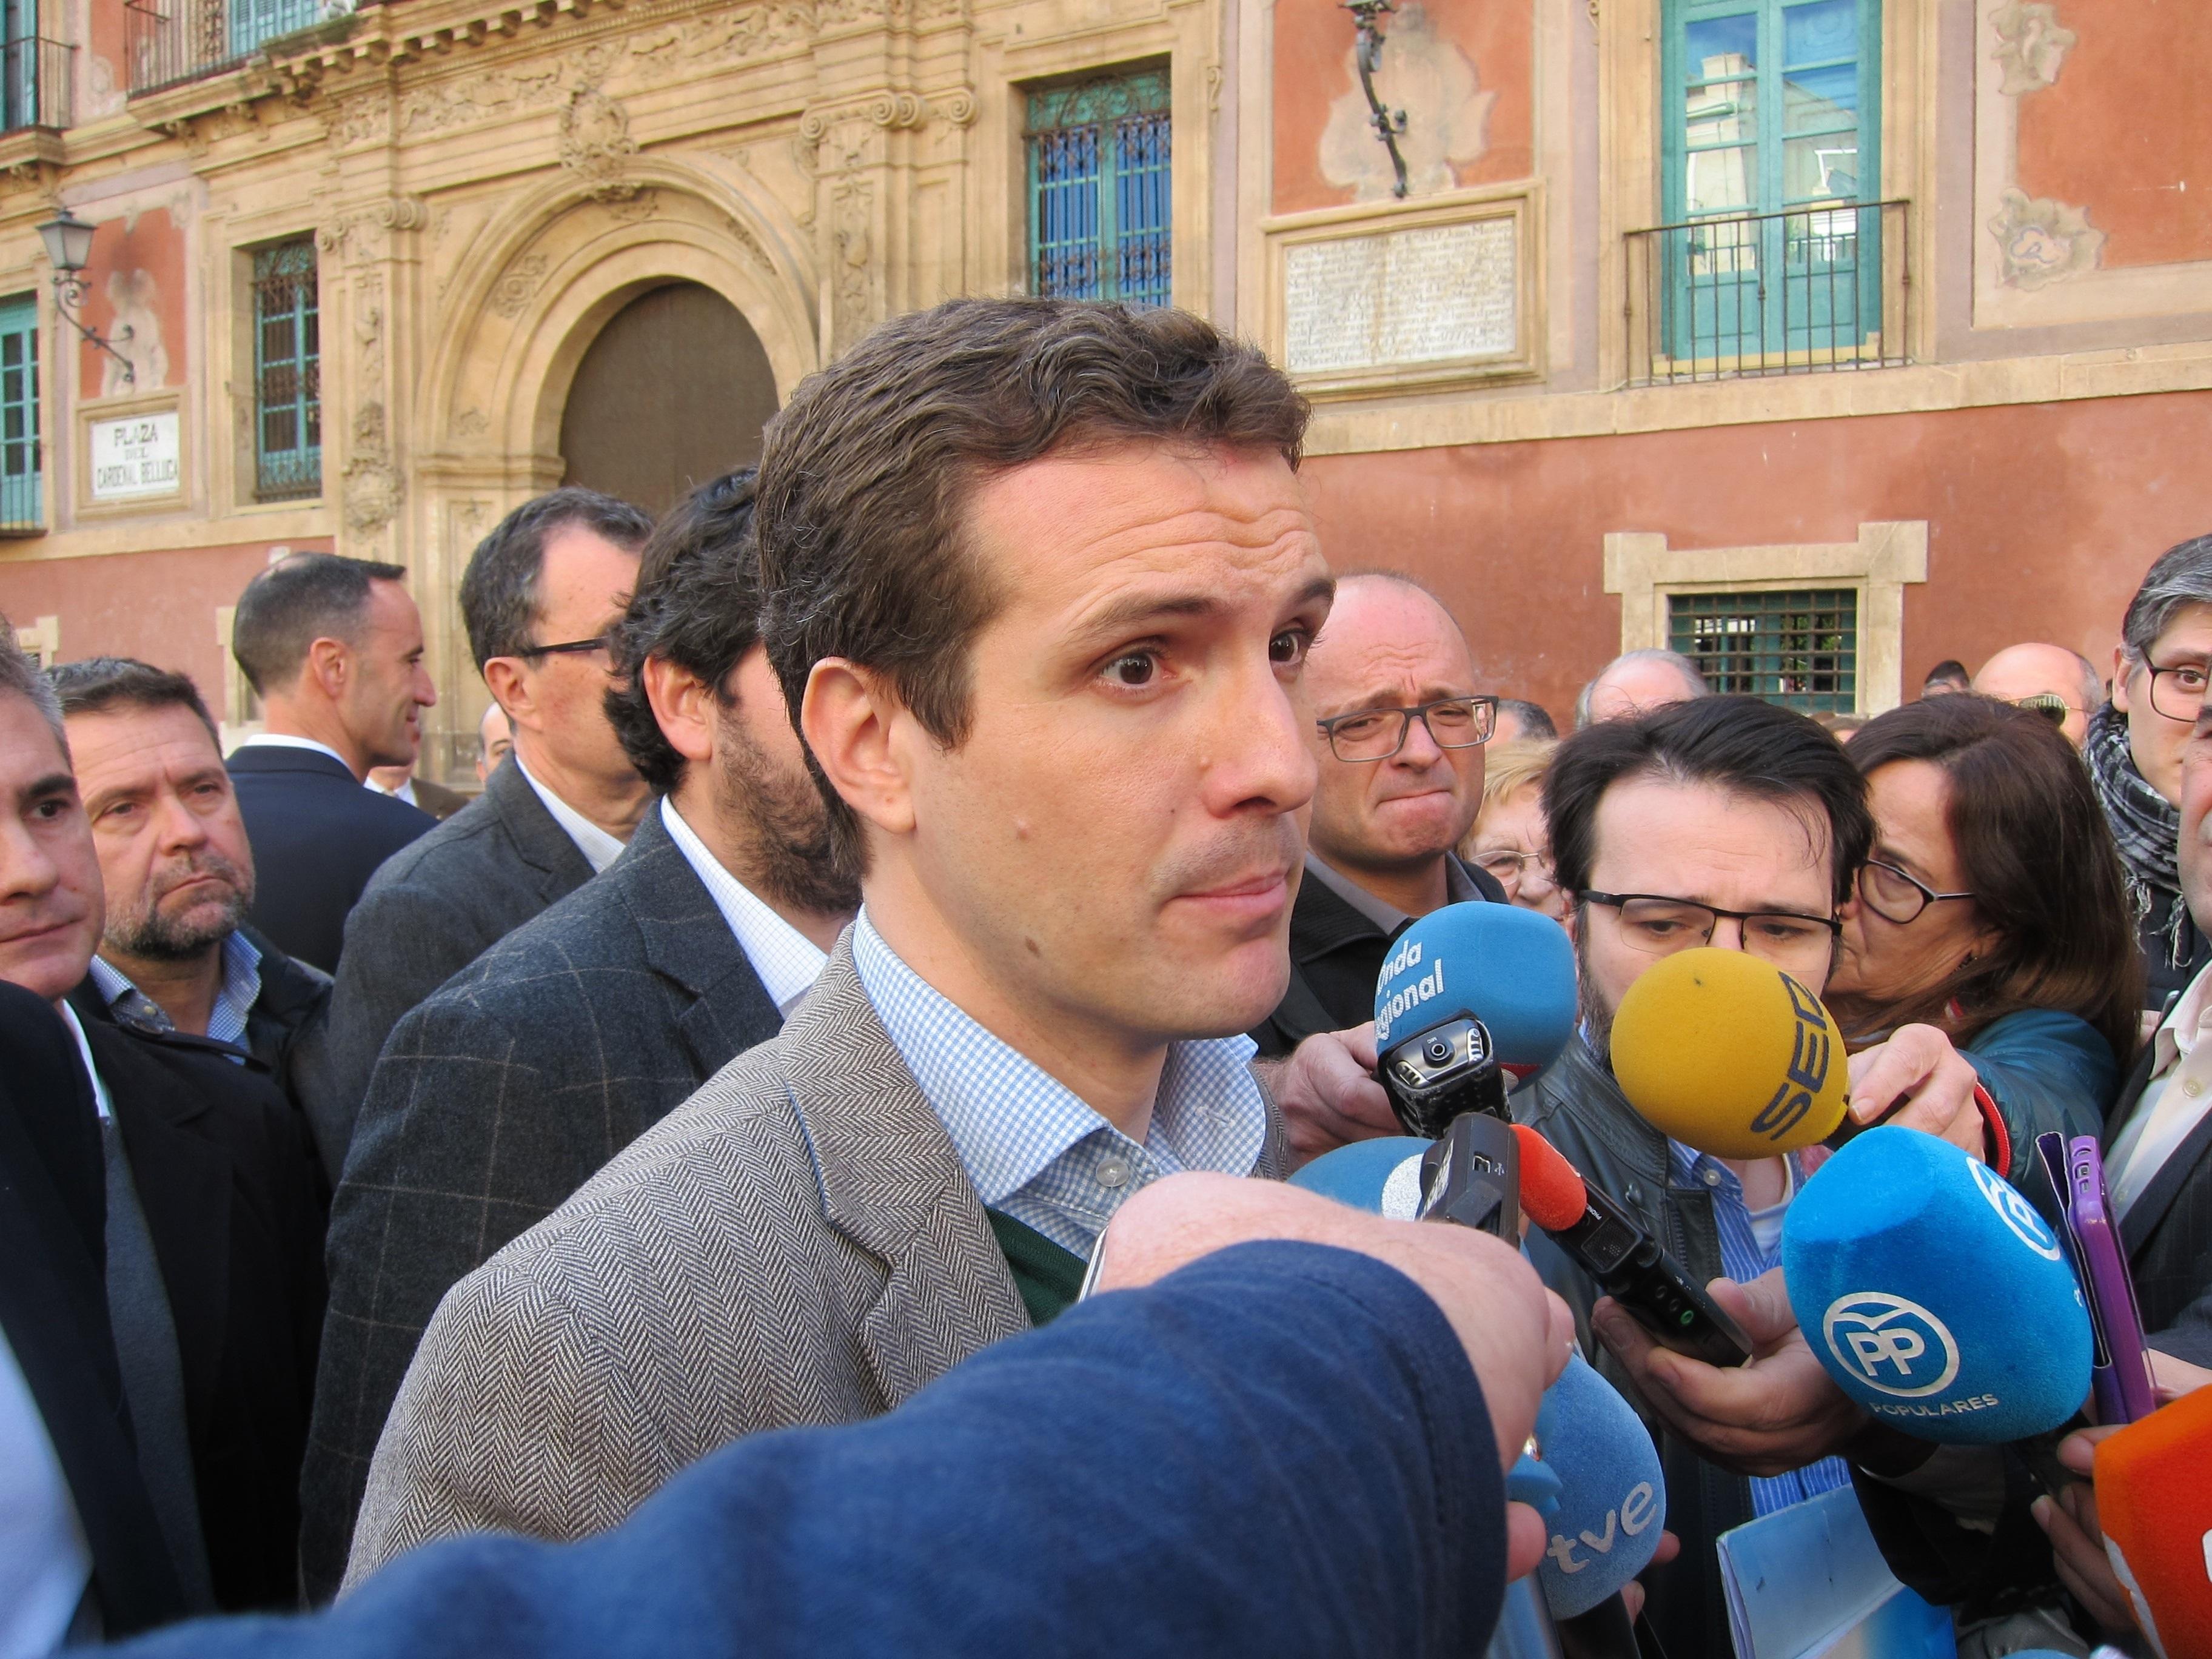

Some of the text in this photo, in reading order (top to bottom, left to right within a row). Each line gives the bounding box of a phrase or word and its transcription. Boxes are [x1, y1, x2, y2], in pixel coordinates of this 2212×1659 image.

[113, 423, 158, 446] PLAZA
[125, 447, 149, 460] DEL
[1845, 1328, 1926, 1377] PP
[1868, 1393, 2000, 1418] POPULARES
[1547, 1480, 1658, 1575] tve
